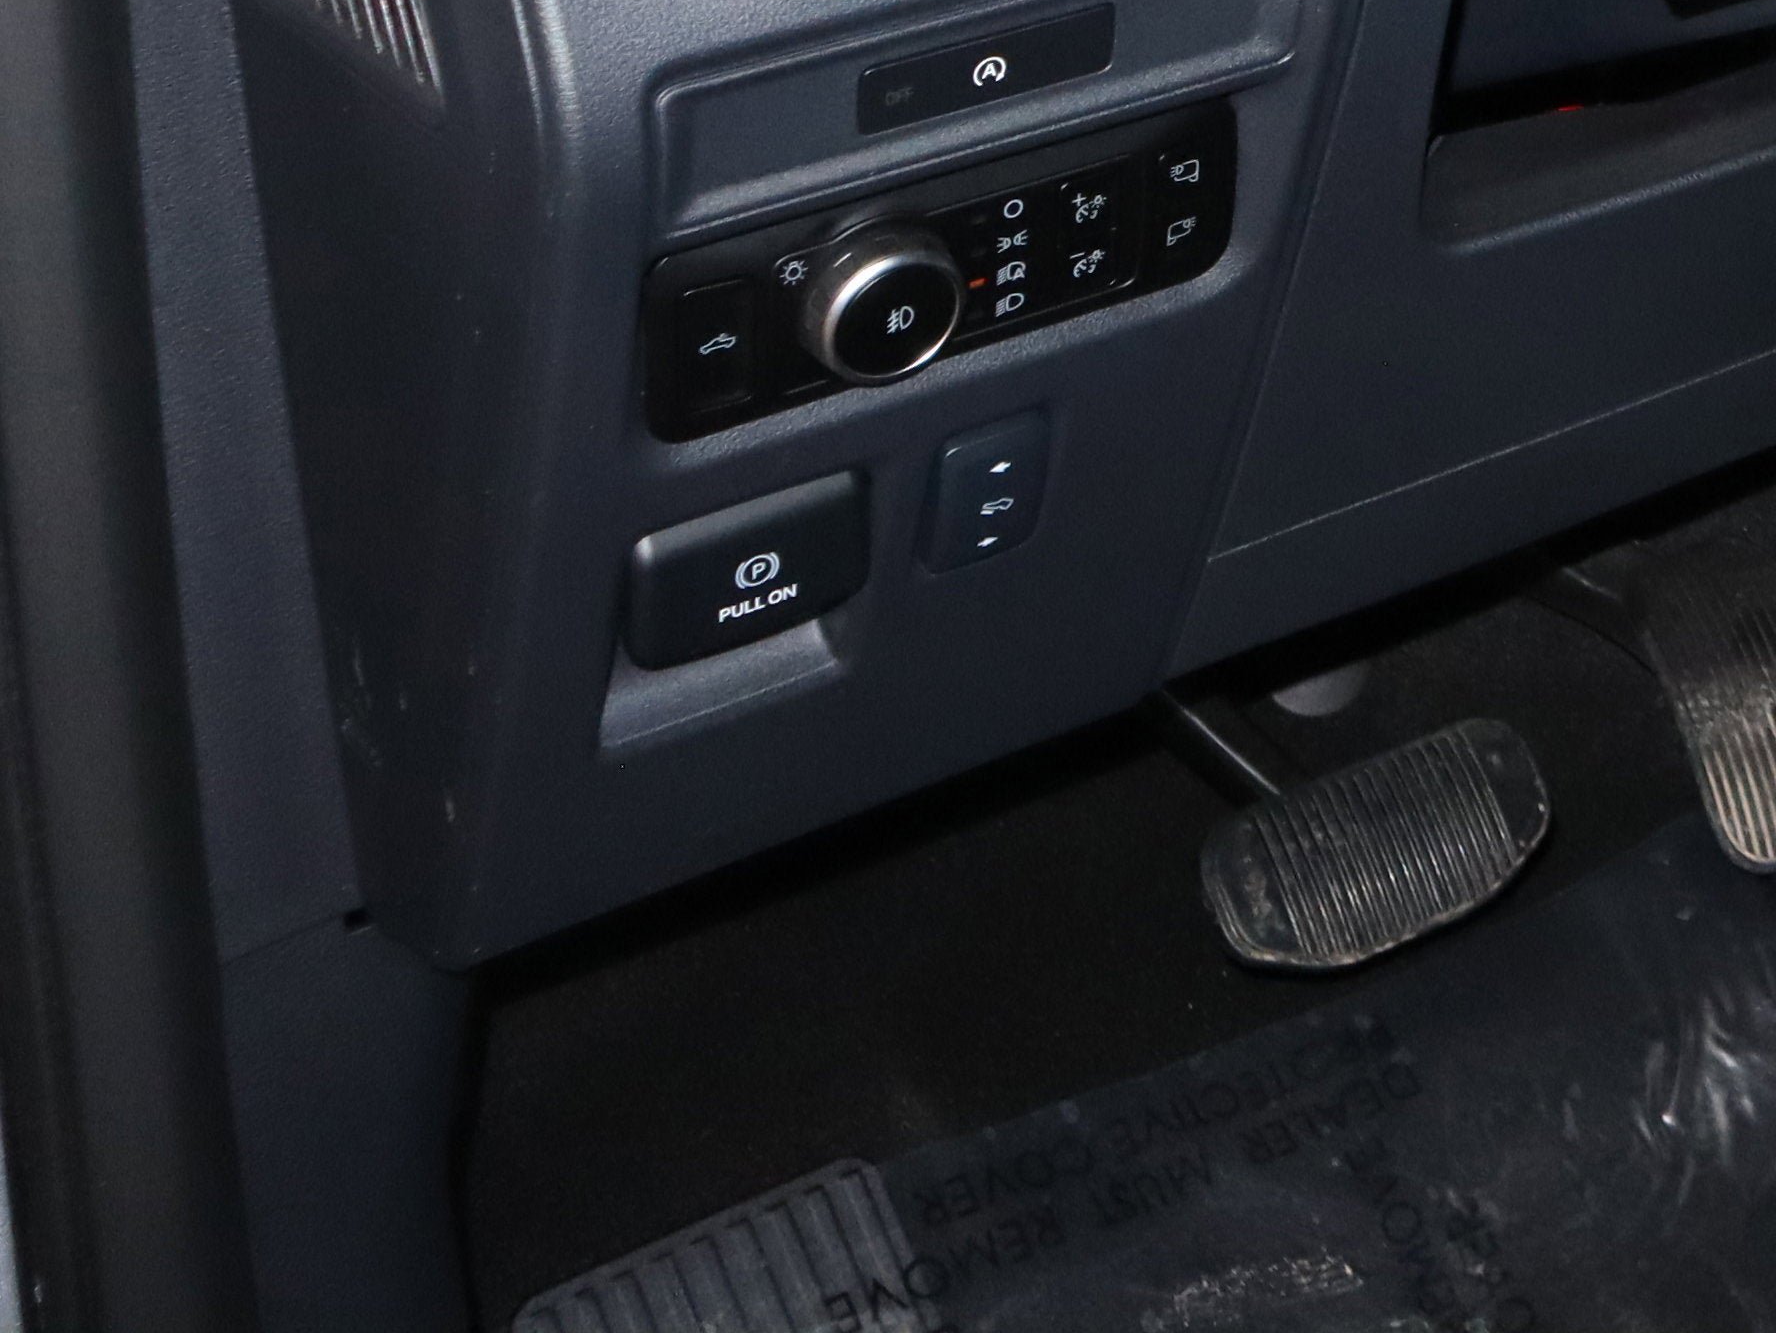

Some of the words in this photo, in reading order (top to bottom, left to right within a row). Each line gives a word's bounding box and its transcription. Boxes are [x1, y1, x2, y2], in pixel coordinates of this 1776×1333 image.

[718, 596, 766, 623] PULL
[767, 583, 798, 605] ON
[914, 1133, 1097, 1229] COVER
[1093, 1143, 1213, 1229] MUST
